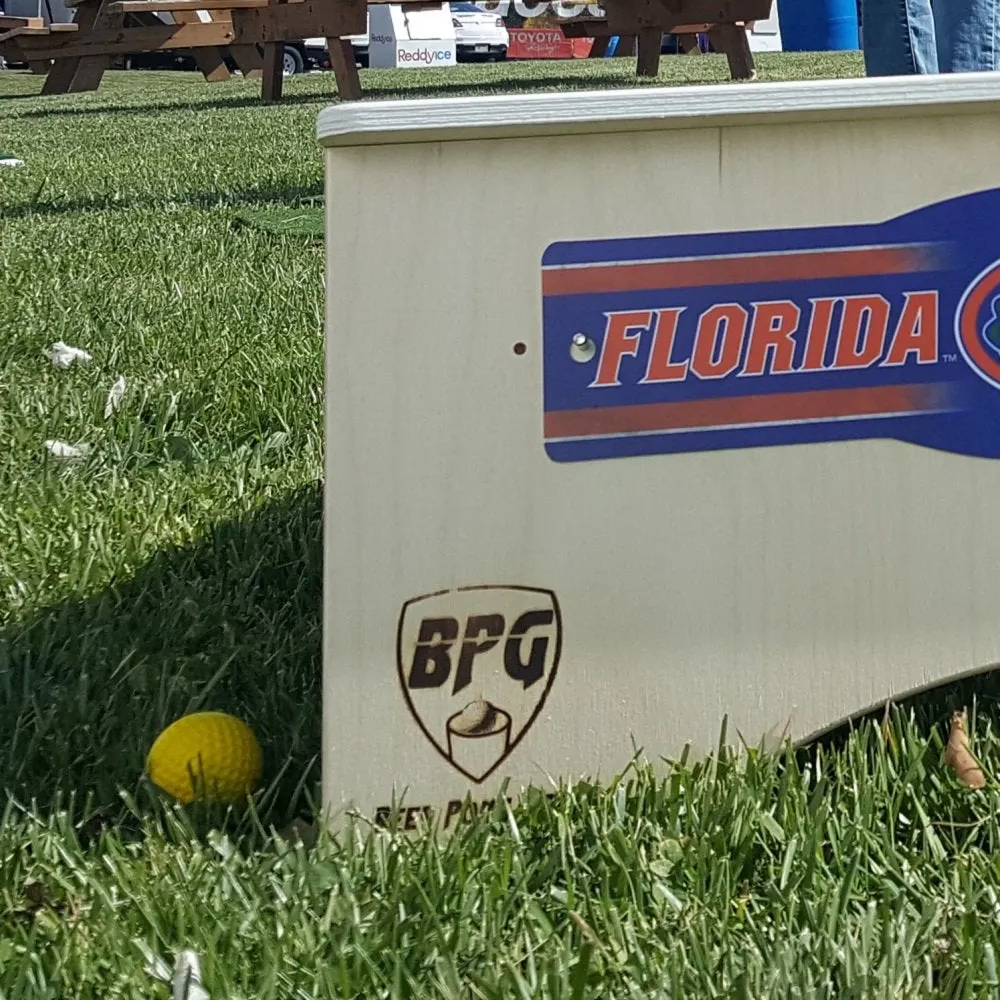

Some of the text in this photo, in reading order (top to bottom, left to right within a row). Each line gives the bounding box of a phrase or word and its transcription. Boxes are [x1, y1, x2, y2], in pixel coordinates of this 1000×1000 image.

[510, 31, 560, 43] TOYOTA
[587, 290, 939, 388] FLORIDA
[408, 608, 555, 697] BPG
